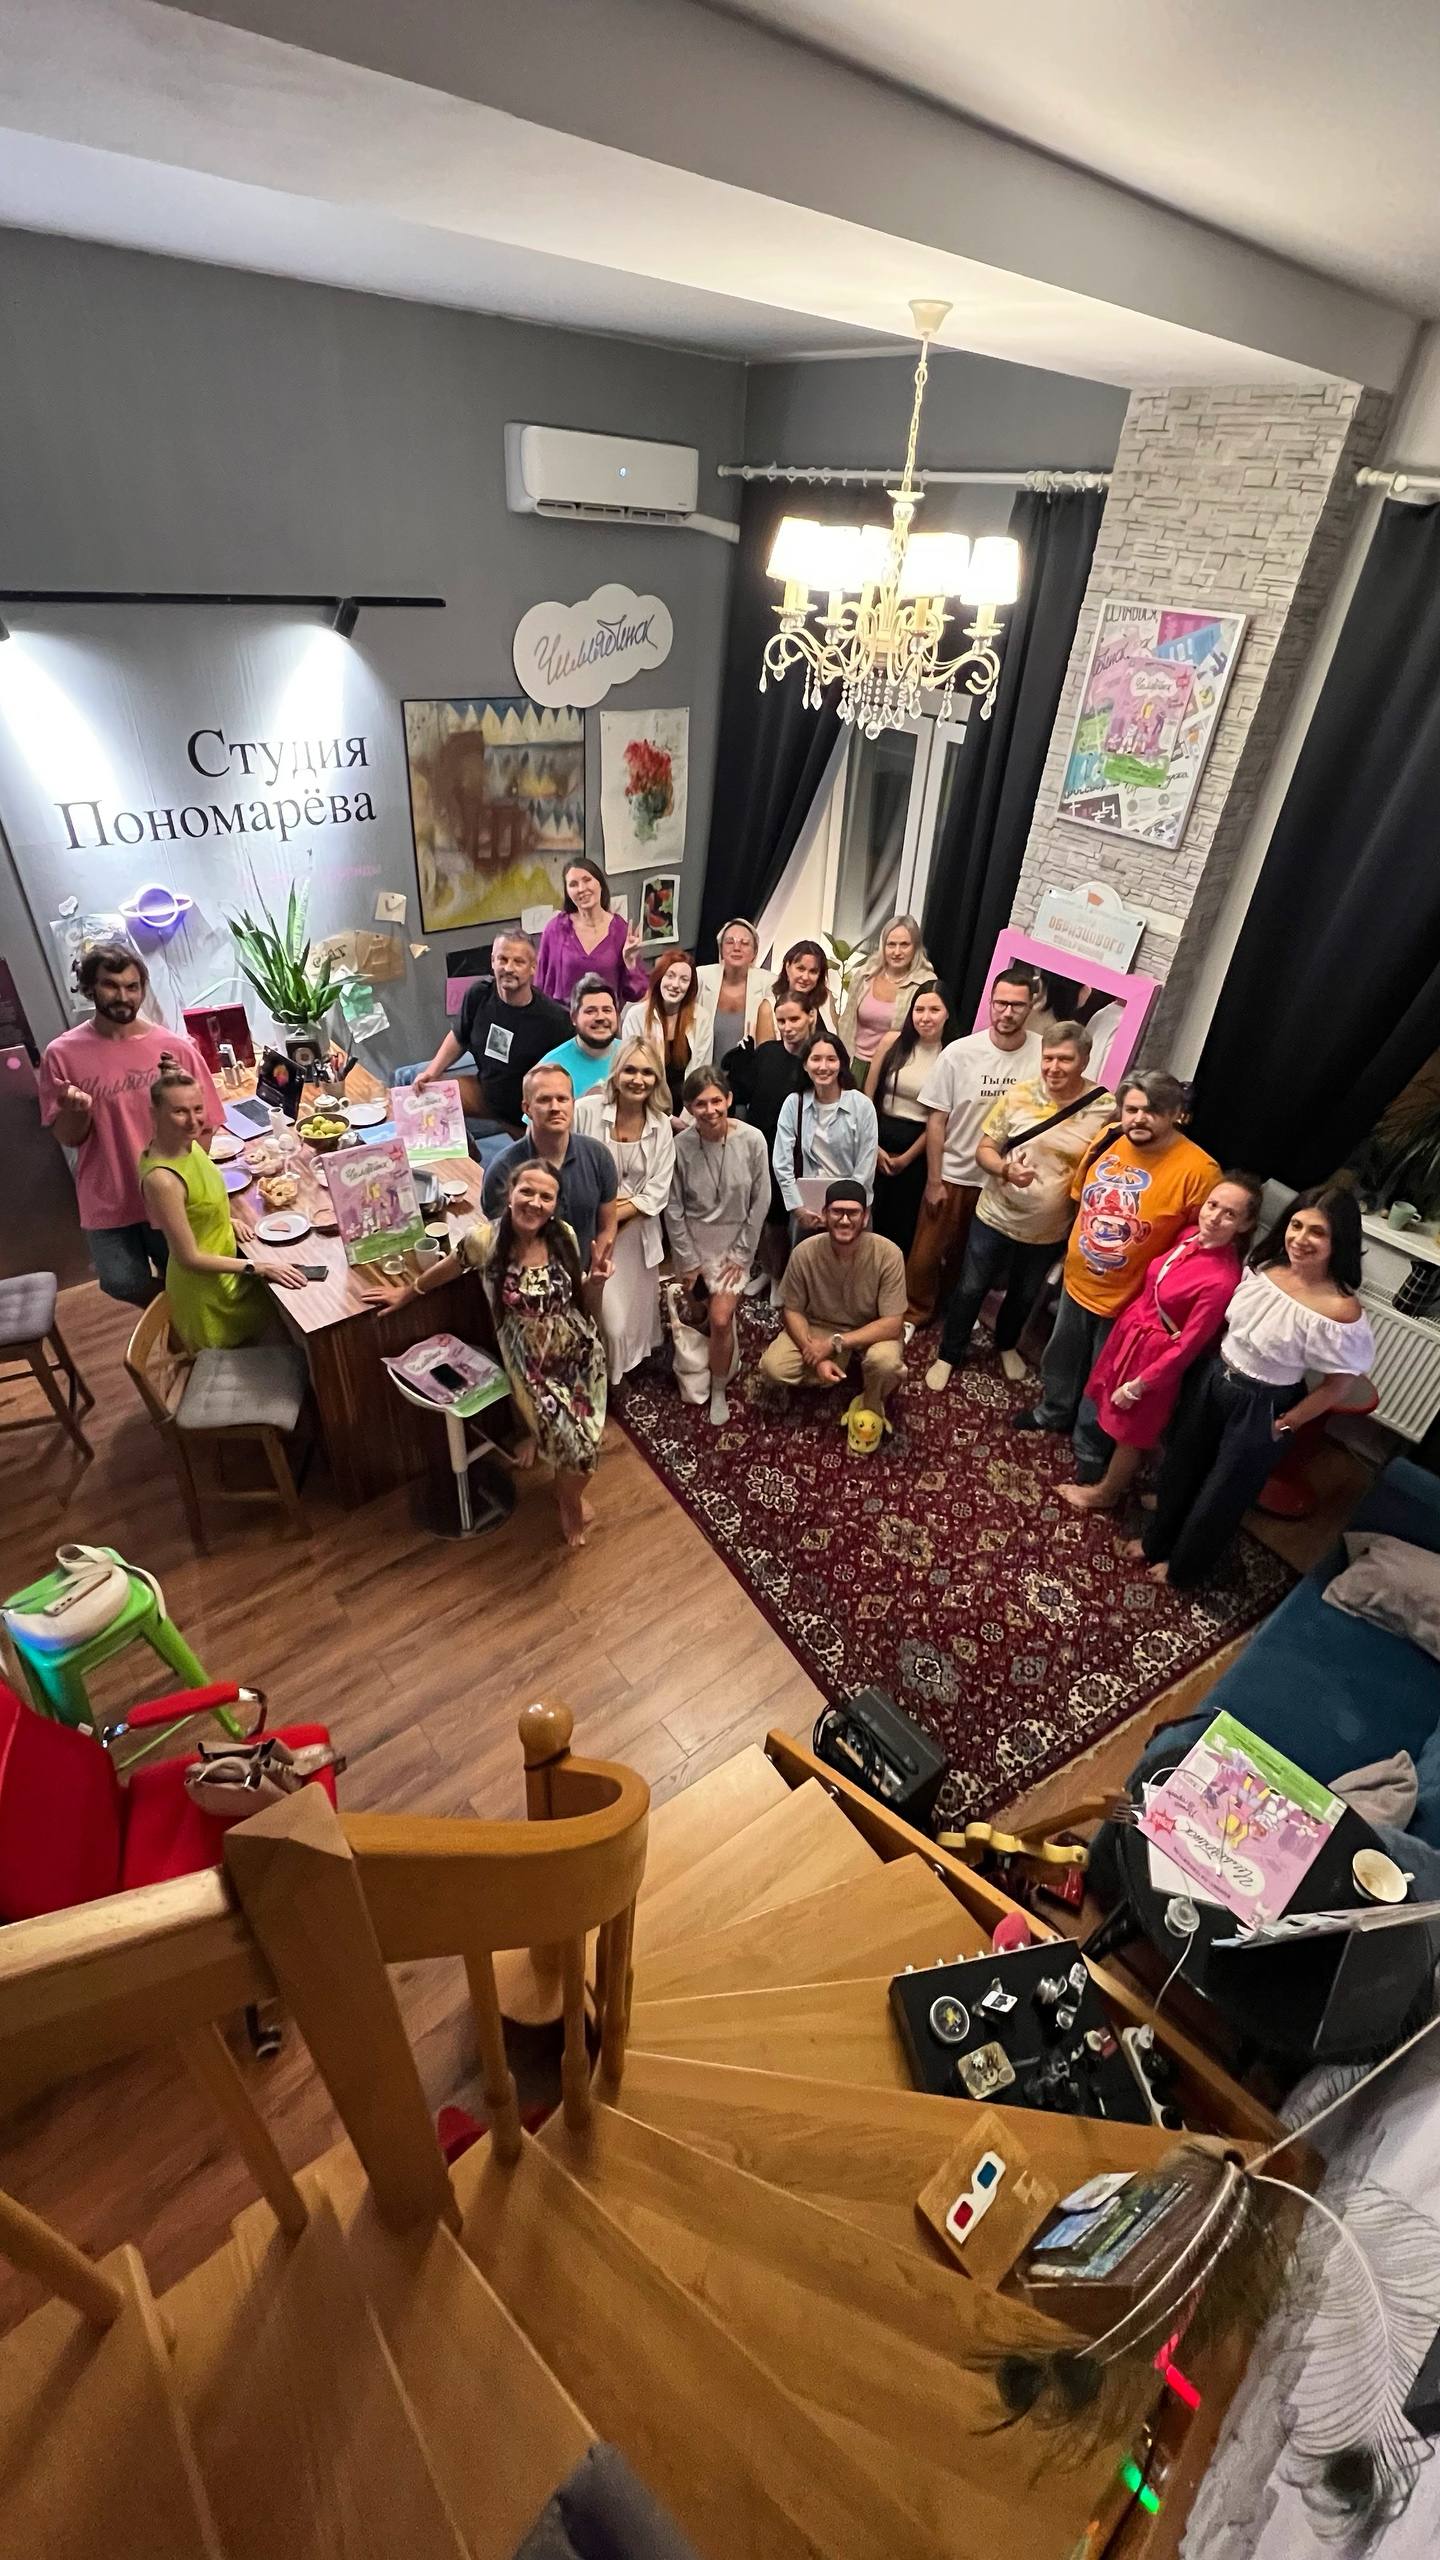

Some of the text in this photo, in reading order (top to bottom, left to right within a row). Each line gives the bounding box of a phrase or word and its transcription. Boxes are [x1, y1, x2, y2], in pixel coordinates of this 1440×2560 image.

[187, 728, 370, 786] Студия
[53, 788, 377, 850] Пономарёва
[981, 1075, 1017, 1086] Ты не
